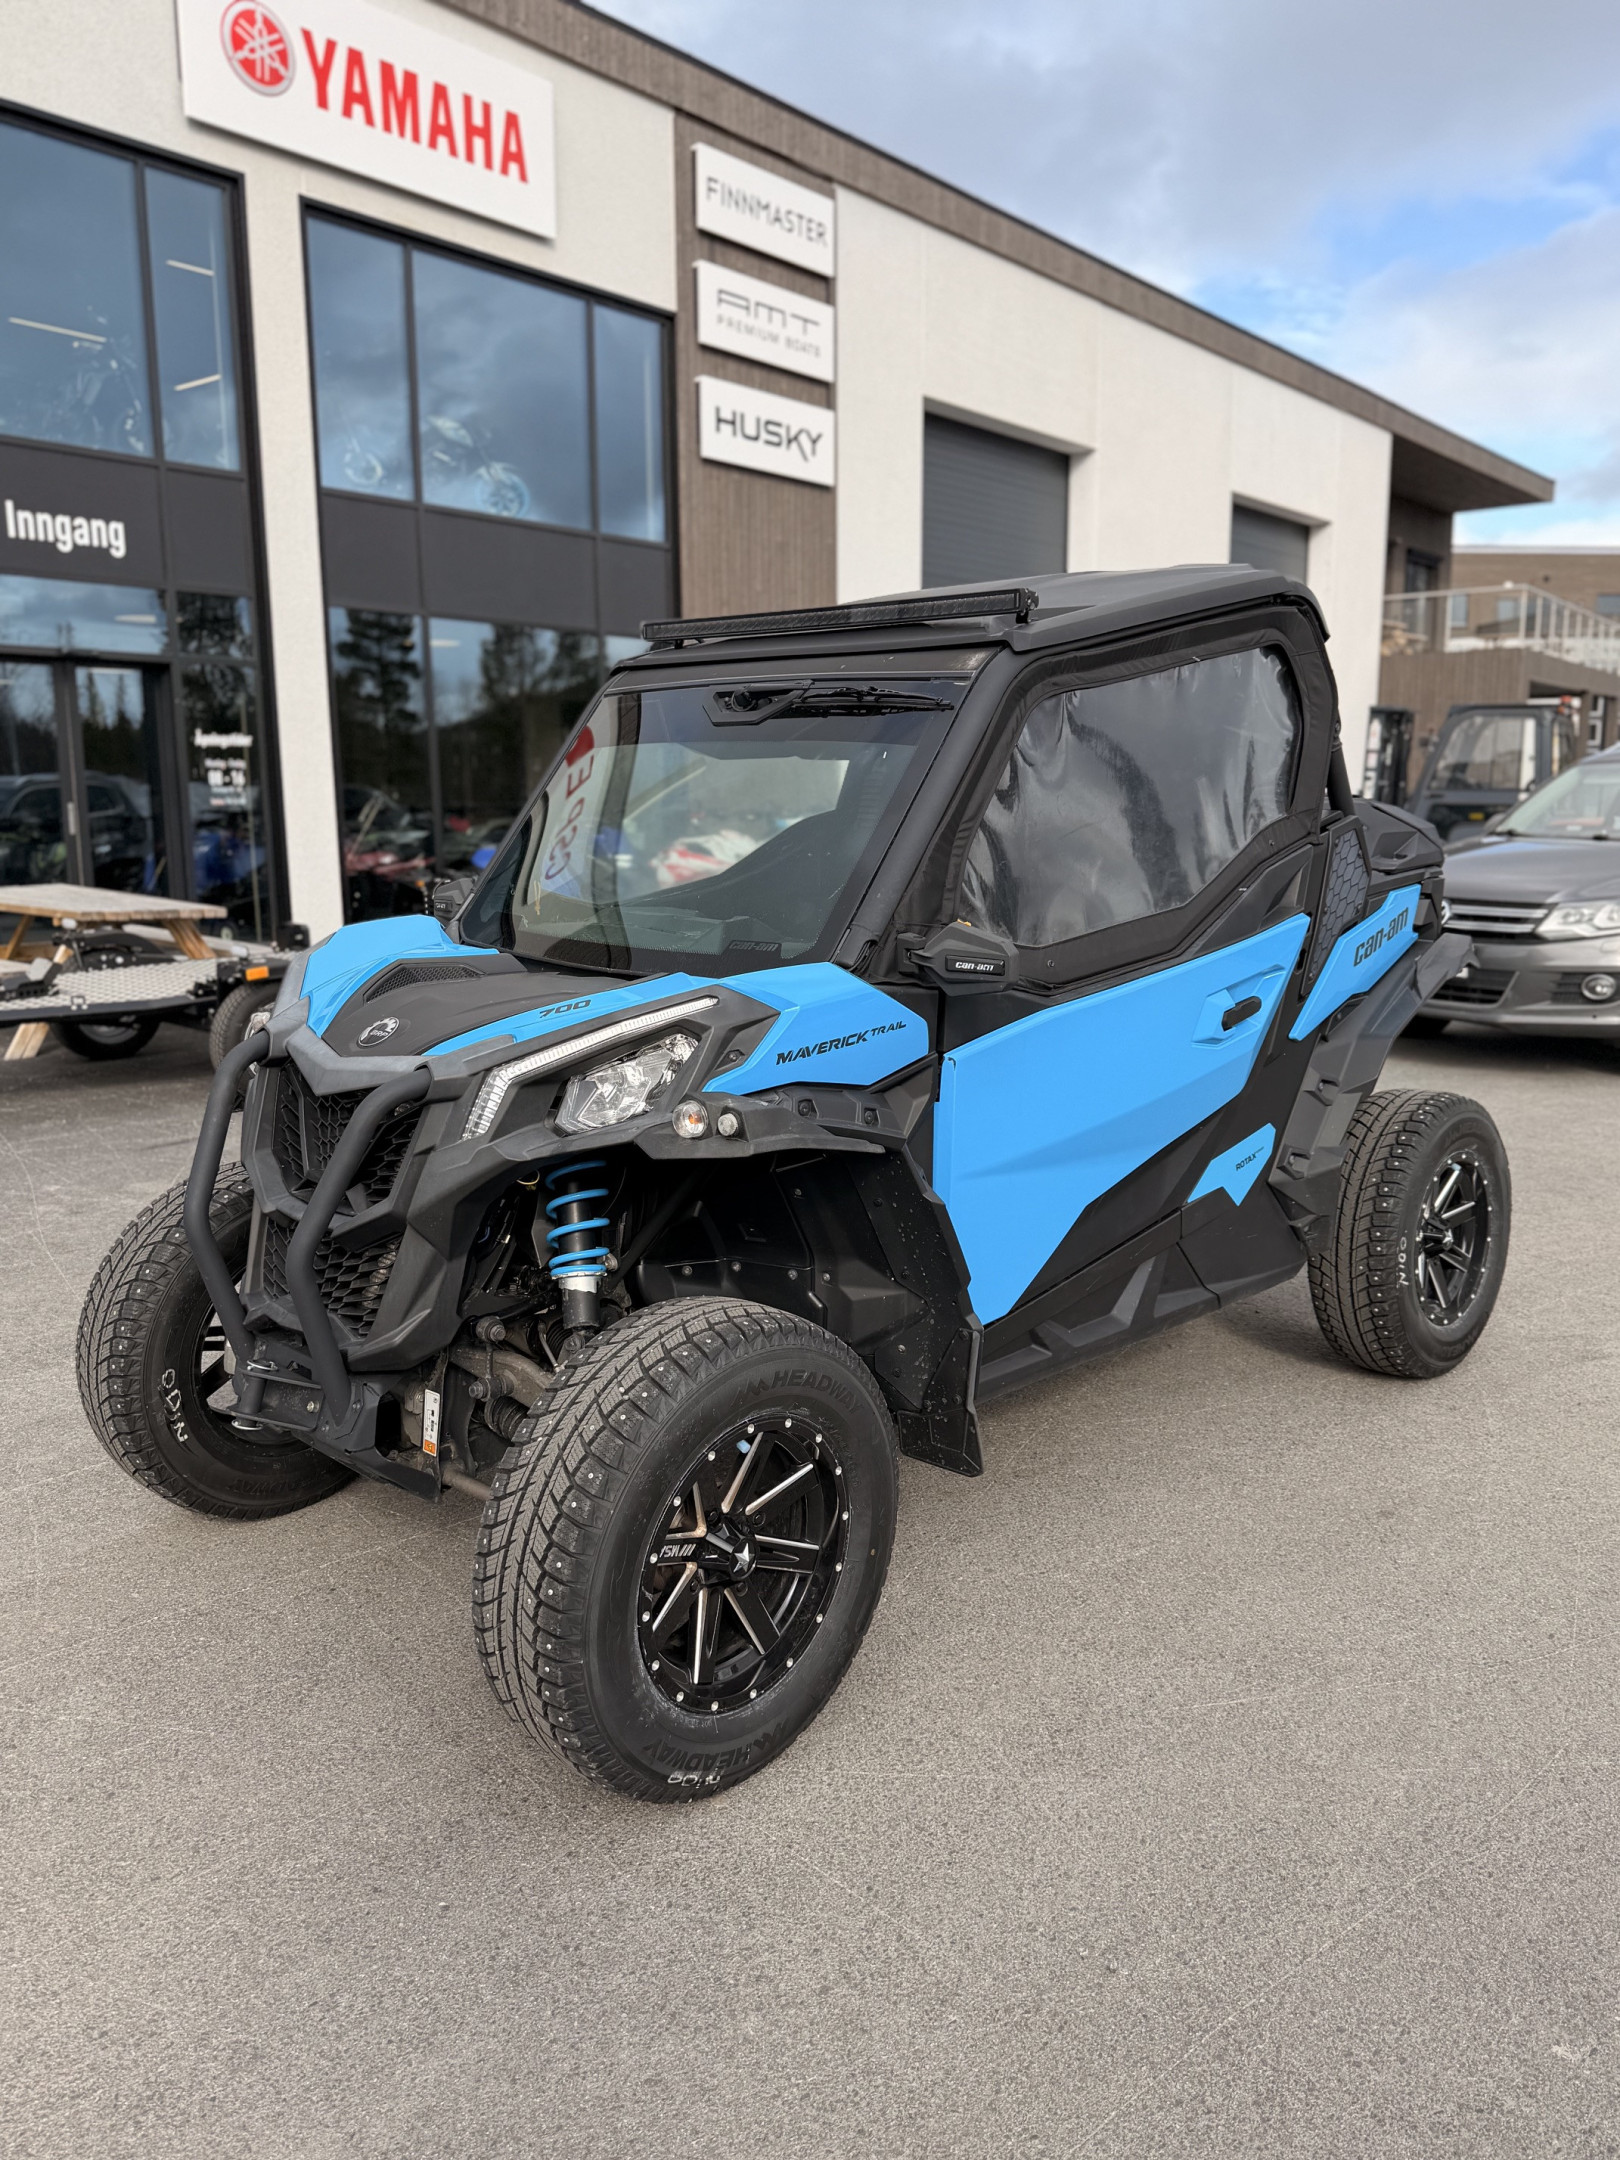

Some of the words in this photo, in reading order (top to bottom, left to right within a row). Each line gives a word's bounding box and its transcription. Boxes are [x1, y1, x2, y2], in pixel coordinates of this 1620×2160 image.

[301, 27, 529, 184] YAMAHA
[706, 175, 828, 248] FINNMASTER
[716, 313, 780, 344] PREMIUM
[714, 405, 823, 463] HUSKY
[4, 499, 127, 559] Inngang
[729, 941, 779, 952] can-am
[1353, 906, 1409, 968] can-am
[954, 961, 995, 972] can-am
[539, 999, 592, 1019] 700
[776, 1029, 870, 1065] MAVERICK
[870, 1020, 907, 1037] TRAIL
[1235, 1153, 1257, 1171] ROTAX
[770, 1369, 865, 1414] HEADWAY
[642, 1737, 750, 1772] HEADWAY
